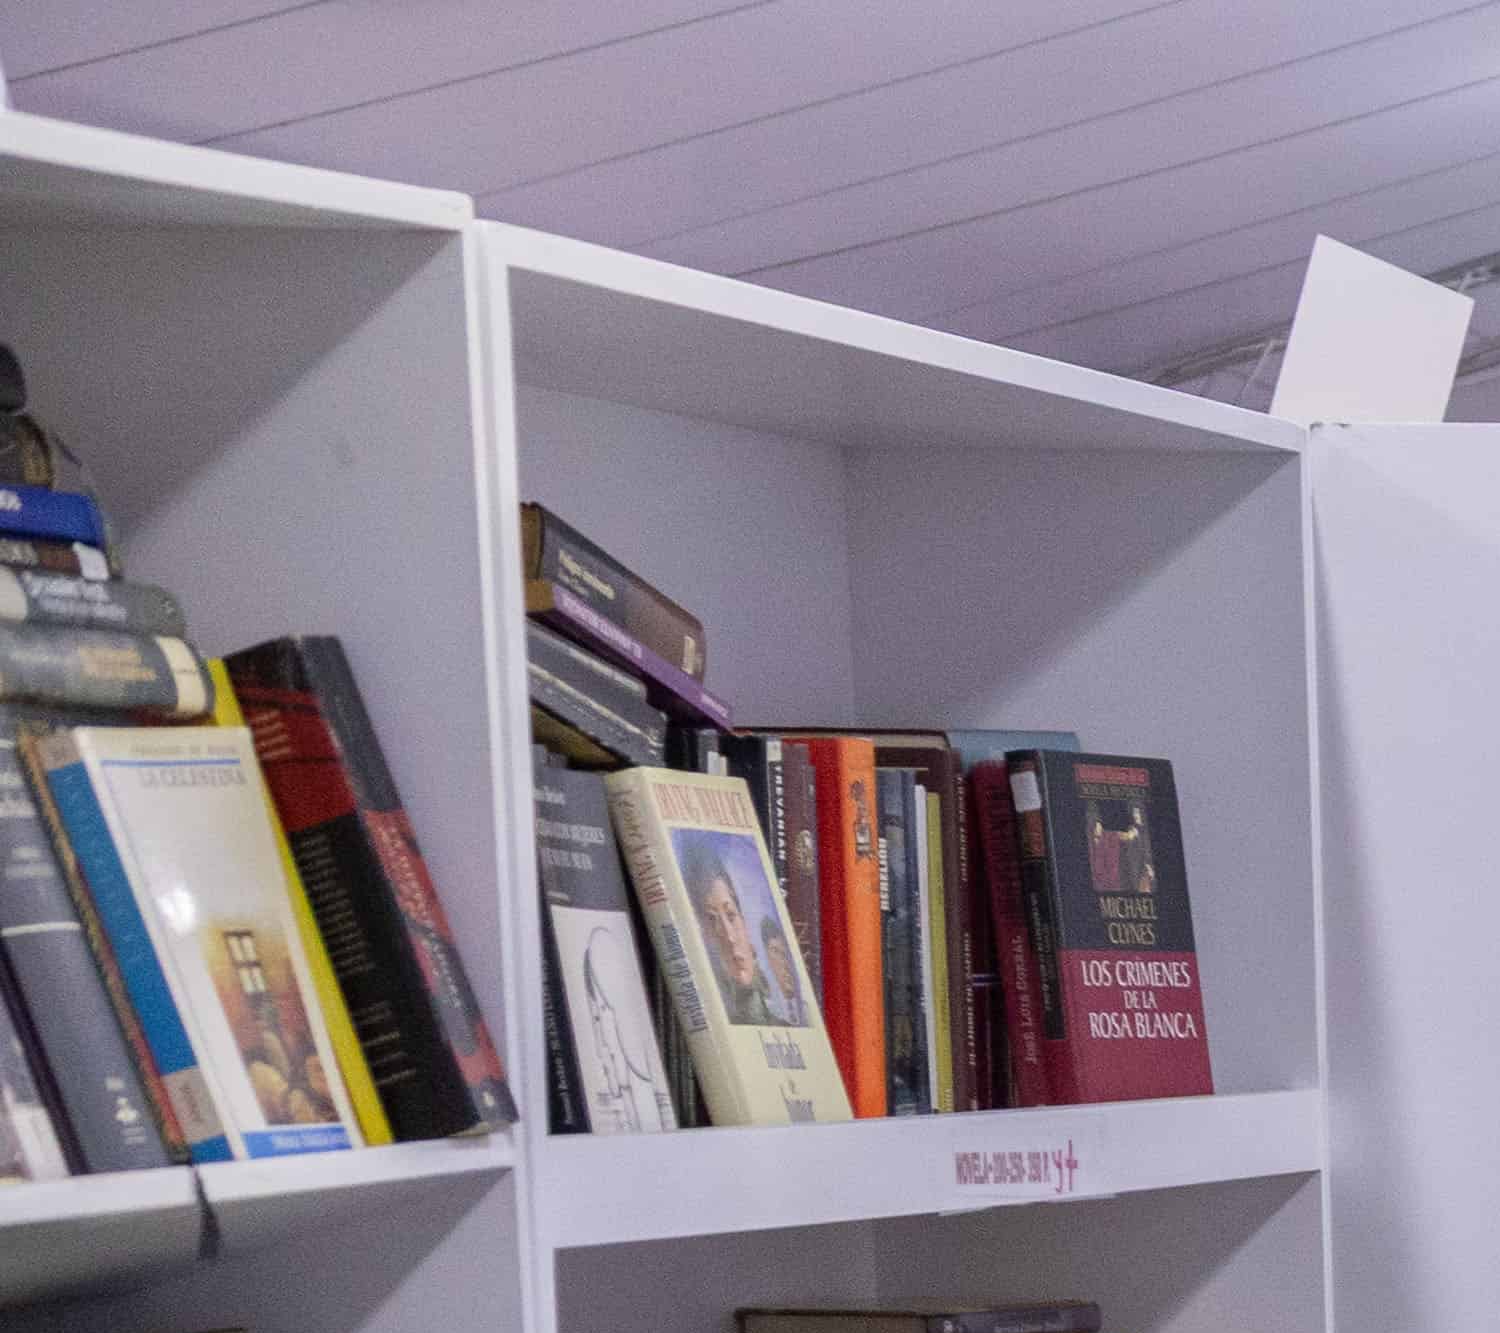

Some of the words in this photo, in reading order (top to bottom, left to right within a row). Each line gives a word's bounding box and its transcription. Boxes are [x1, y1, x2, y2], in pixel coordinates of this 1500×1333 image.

[1100, 895, 1157, 922] MICHAEL
[1108, 922, 1155, 946] CLYNES
[1081, 960, 1111, 988] LOS
[1123, 990, 1140, 1009] DE
[1142, 991, 1158, 1009] LA
[1088, 1013, 1134, 1039] ROSA
[1136, 1012, 1198, 1040] BLANCA
